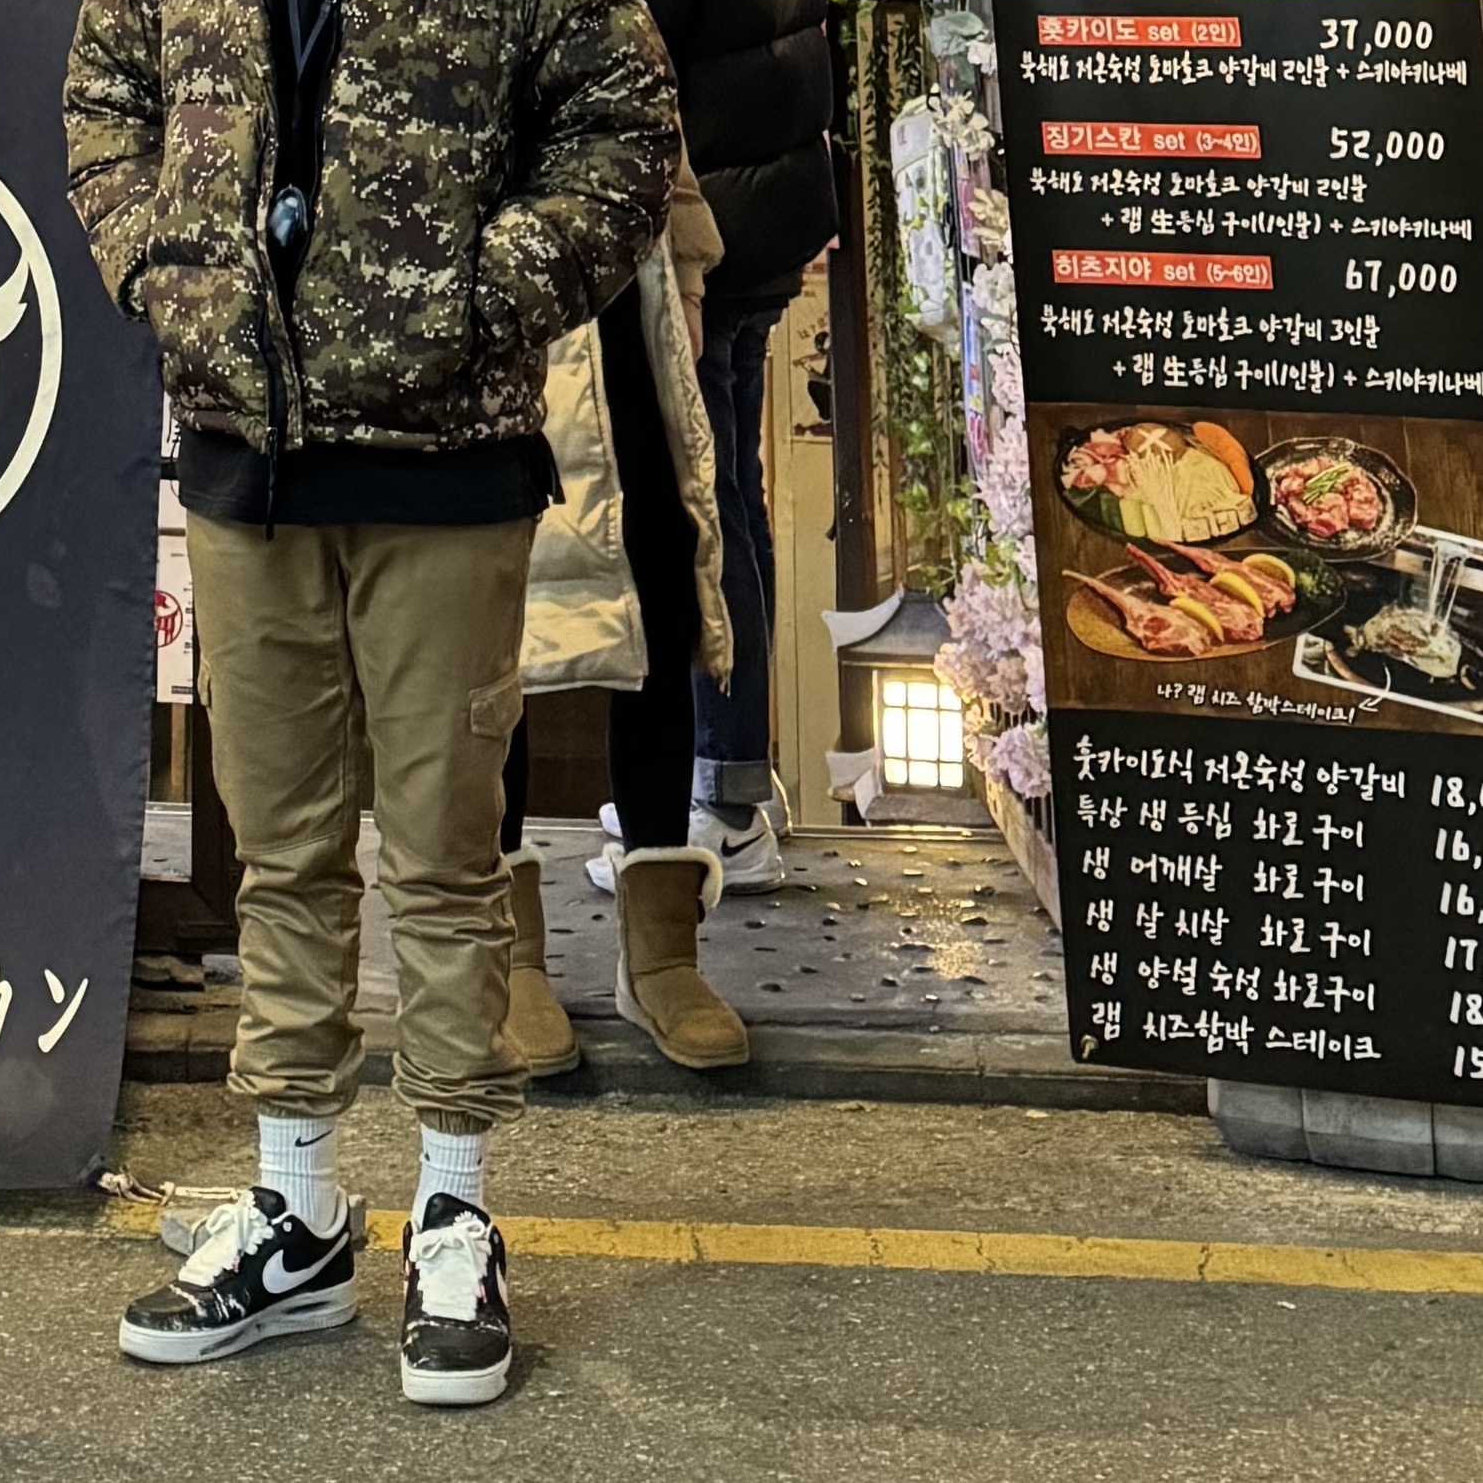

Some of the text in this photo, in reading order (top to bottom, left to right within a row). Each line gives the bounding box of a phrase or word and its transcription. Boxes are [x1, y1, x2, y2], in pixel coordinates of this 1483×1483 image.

[1320, 19, 1433, 57] 37,000
[1047, 124, 1141, 152] 징기스칸
[1154, 131, 1185, 151] set
[1329, 127, 1444, 166] 52,000
[1055, 255, 1152, 282] 히츠지야
[1163, 261, 1195, 282] set
[1346, 259, 1457, 299] 67,000
[1205, 750, 1306, 793] 저온숙성
[1317, 762, 1406, 801] 양갈비
[1140, 799, 1166, 832] 생
[1083, 847, 1110, 880] 생
[1086, 899, 1113, 932] 생
[1090, 952, 1117, 985] 생
[1208, 961, 1261, 1001] 숙성
[1092, 1002, 1121, 1041] 램
[1266, 1026, 1382, 1061] 스테이크
